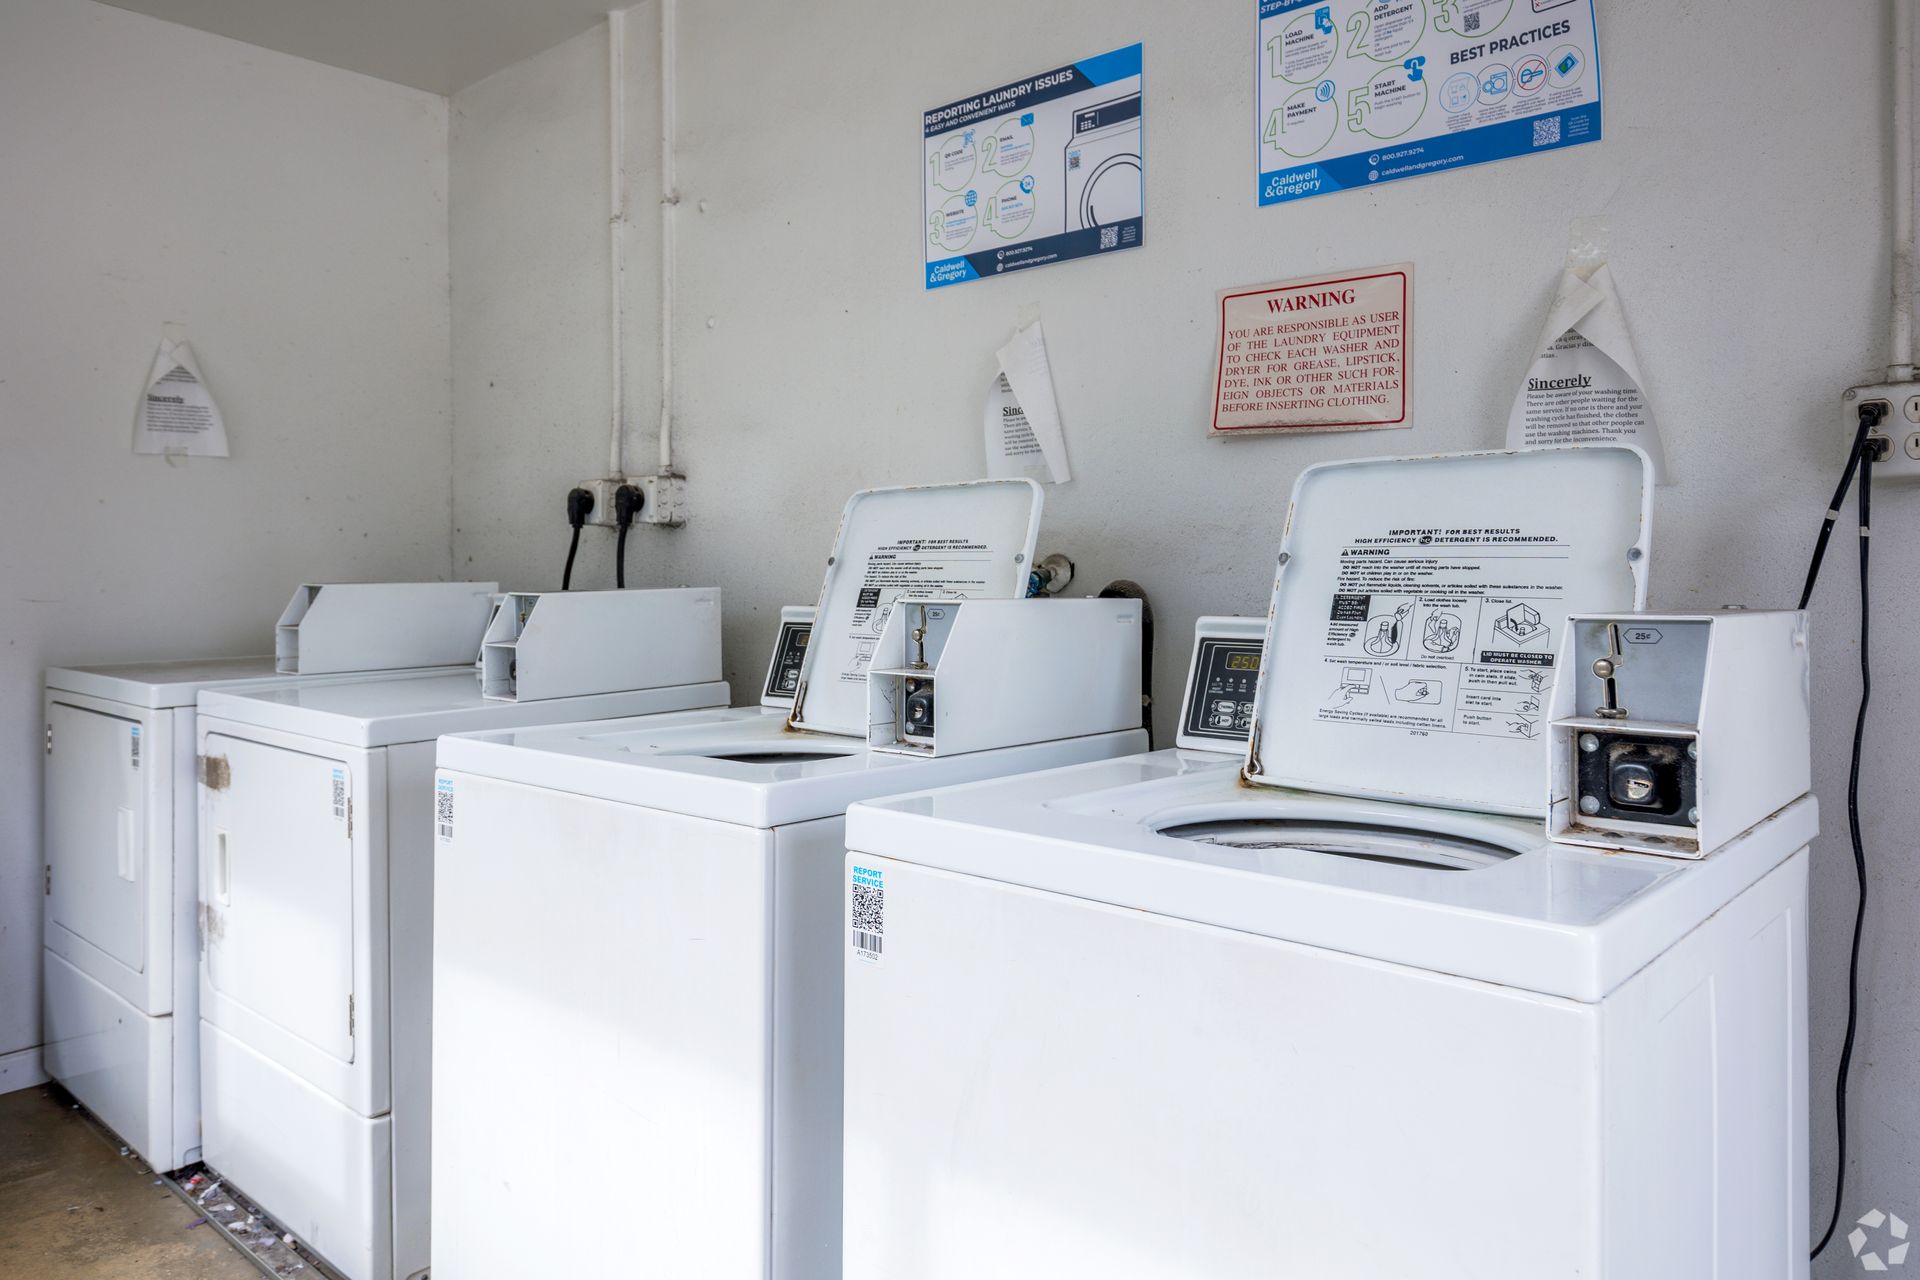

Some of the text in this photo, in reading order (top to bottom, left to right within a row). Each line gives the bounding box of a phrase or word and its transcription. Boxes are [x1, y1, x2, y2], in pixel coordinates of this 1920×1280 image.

[1374, 4, 1389, 13] ADD
[1374, 4, 1413, 21] DETERGENT
[1285, 30, 1303, 39] LOAD
[1285, 34, 1314, 46] MACHINE
[1450, 20, 1571, 65] BEST PRACTICES
[1374, 80, 1396, 89] START
[1374, 85, 1406, 98] MACHINE
[925, 70, 1073, 125] REPORTING LAUNDRY ISSUES
[1287, 102, 1305, 111] MAKE
[1287, 107, 1317, 118] PAYMENT
[930, 122, 944, 132] EASY
[946, 118, 959, 127] AND
[960, 107, 996, 123] CONVENIENT
[998, 100, 1016, 111] WAYS
[1382, 147, 1424, 161] 800.927.9274
[1382, 155, 1464, 176] caldwellandgregory.com
[1272, 168, 1318, 186] Caldwell
[1265, 179, 1321, 197] &Gregory
[930, 269, 967, 283] &Gregory
[934, 261, 965, 275] Caldwell
[1267, 289, 1356, 313] WARNING
[1228, 311, 1399, 339] YOU ARE RESPONSIBLE AS USER
[1228, 324, 1400, 351] OF THE LAUNDRY EQUIPMENT
[1227, 338, 1399, 364] TO CHECK EACH WASHER AND
[1225, 365, 1260, 376] DRYER
[1267, 363, 1287, 373] FOR
[1253, 376, 1272, 386] INK
[1276, 375, 1291, 384] OR
[1296, 372, 1333, 383] OTHER
[1338, 369, 1368, 380] SUCH
[1372, 366, 1399, 376] FOR-
[1223, 380, 1399, 400] EIGN OBJECTS OR MATERIALS
[1528, 374, 1592, 391] Sincerely
[1222, 394, 1390, 412] BEFORE INSERTING CLOTHING.
[853, 866, 882, 878] REPORT
[852, 875, 884, 888] SERVICE
